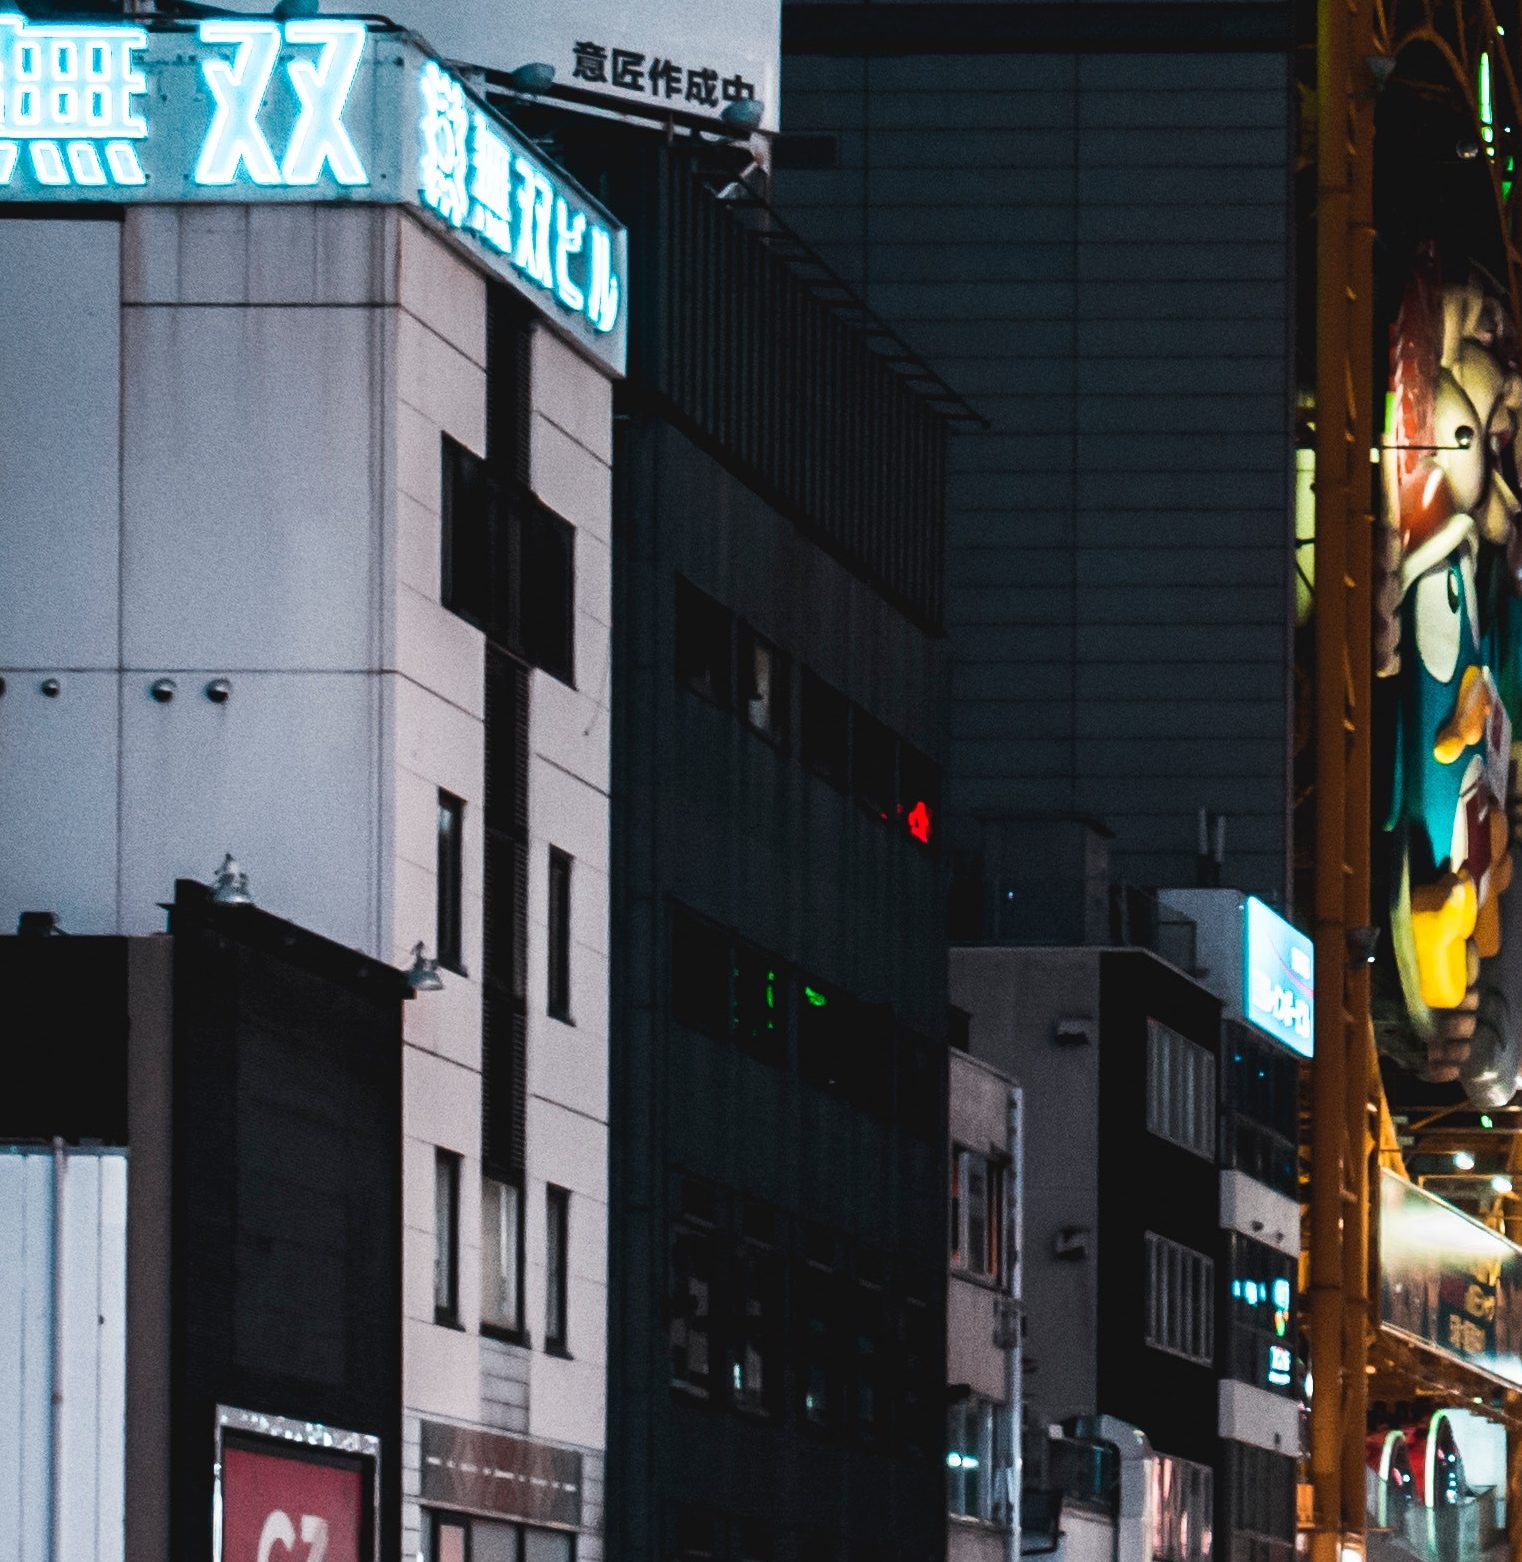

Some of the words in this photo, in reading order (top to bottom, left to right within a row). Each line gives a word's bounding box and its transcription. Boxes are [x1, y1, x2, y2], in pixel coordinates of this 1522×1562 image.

[573, 40, 755, 107] 意匠作成中
